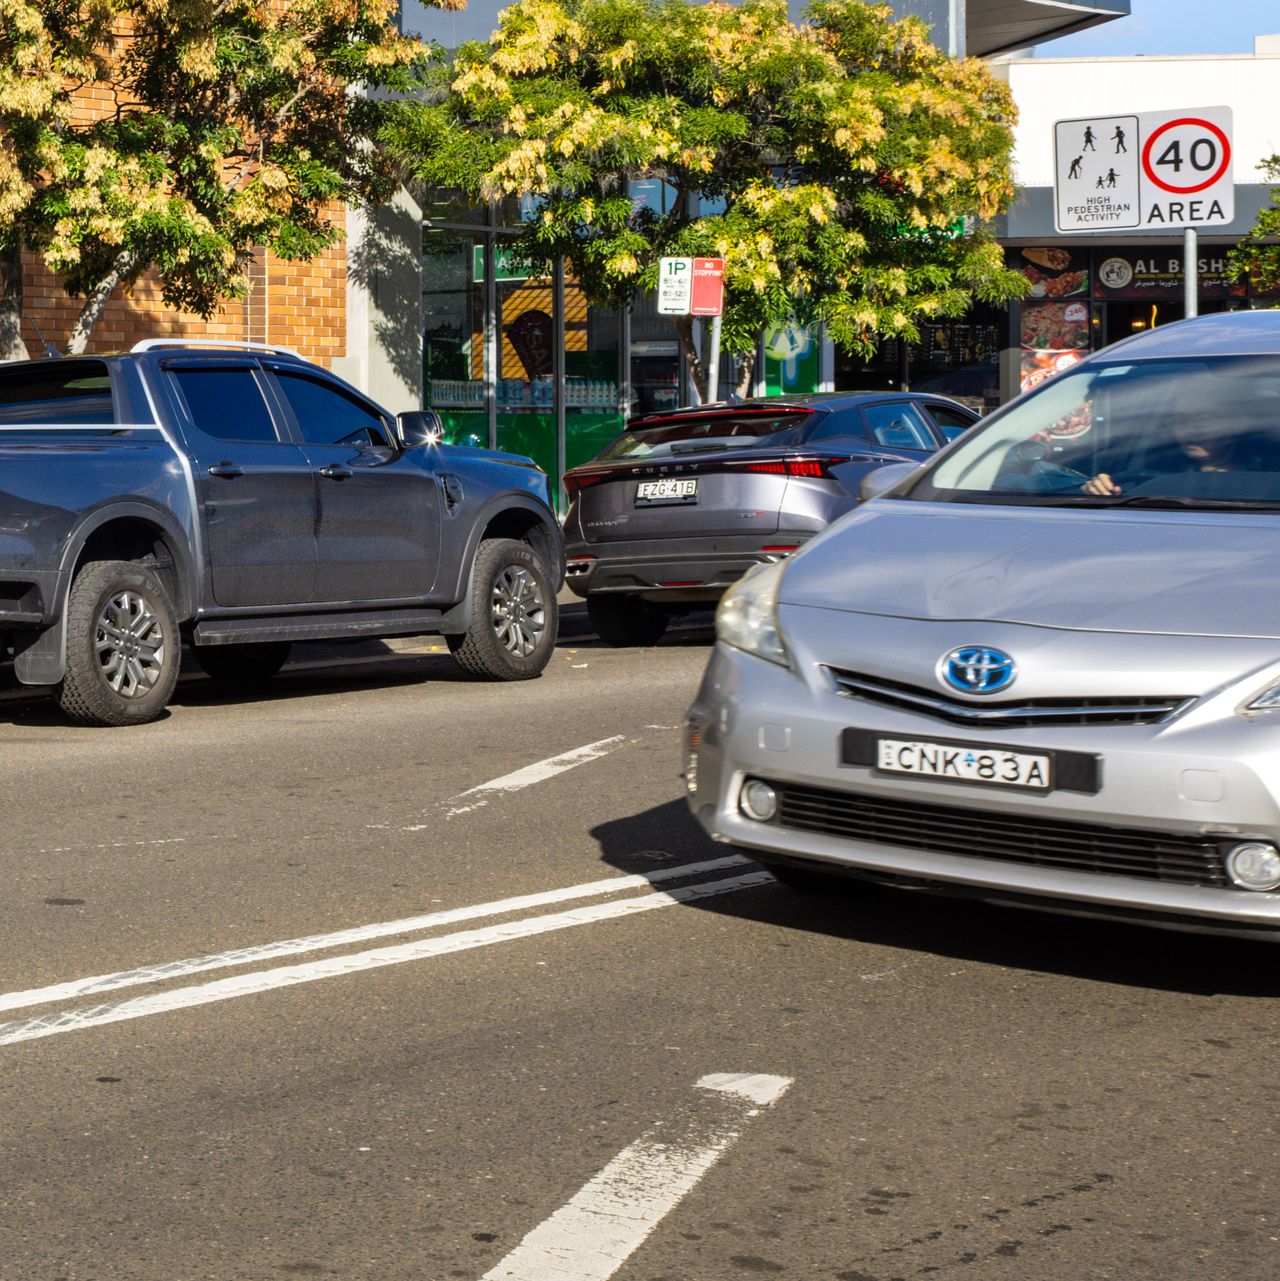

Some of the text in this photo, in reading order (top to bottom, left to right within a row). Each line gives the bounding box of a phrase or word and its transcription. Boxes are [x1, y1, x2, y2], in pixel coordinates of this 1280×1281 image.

[1155, 138, 1217, 172] 40
[1086, 196, 1111, 205] HIGH
[1067, 204, 1131, 214] PEDESTRIAN
[1147, 199, 1225, 224] AREA
[1076, 213, 1121, 222] ACTIVITY
[668, 262, 686, 275] 1P
[1135, 259, 1159, 273] AL
[632, 464, 699, 474] CHERY
